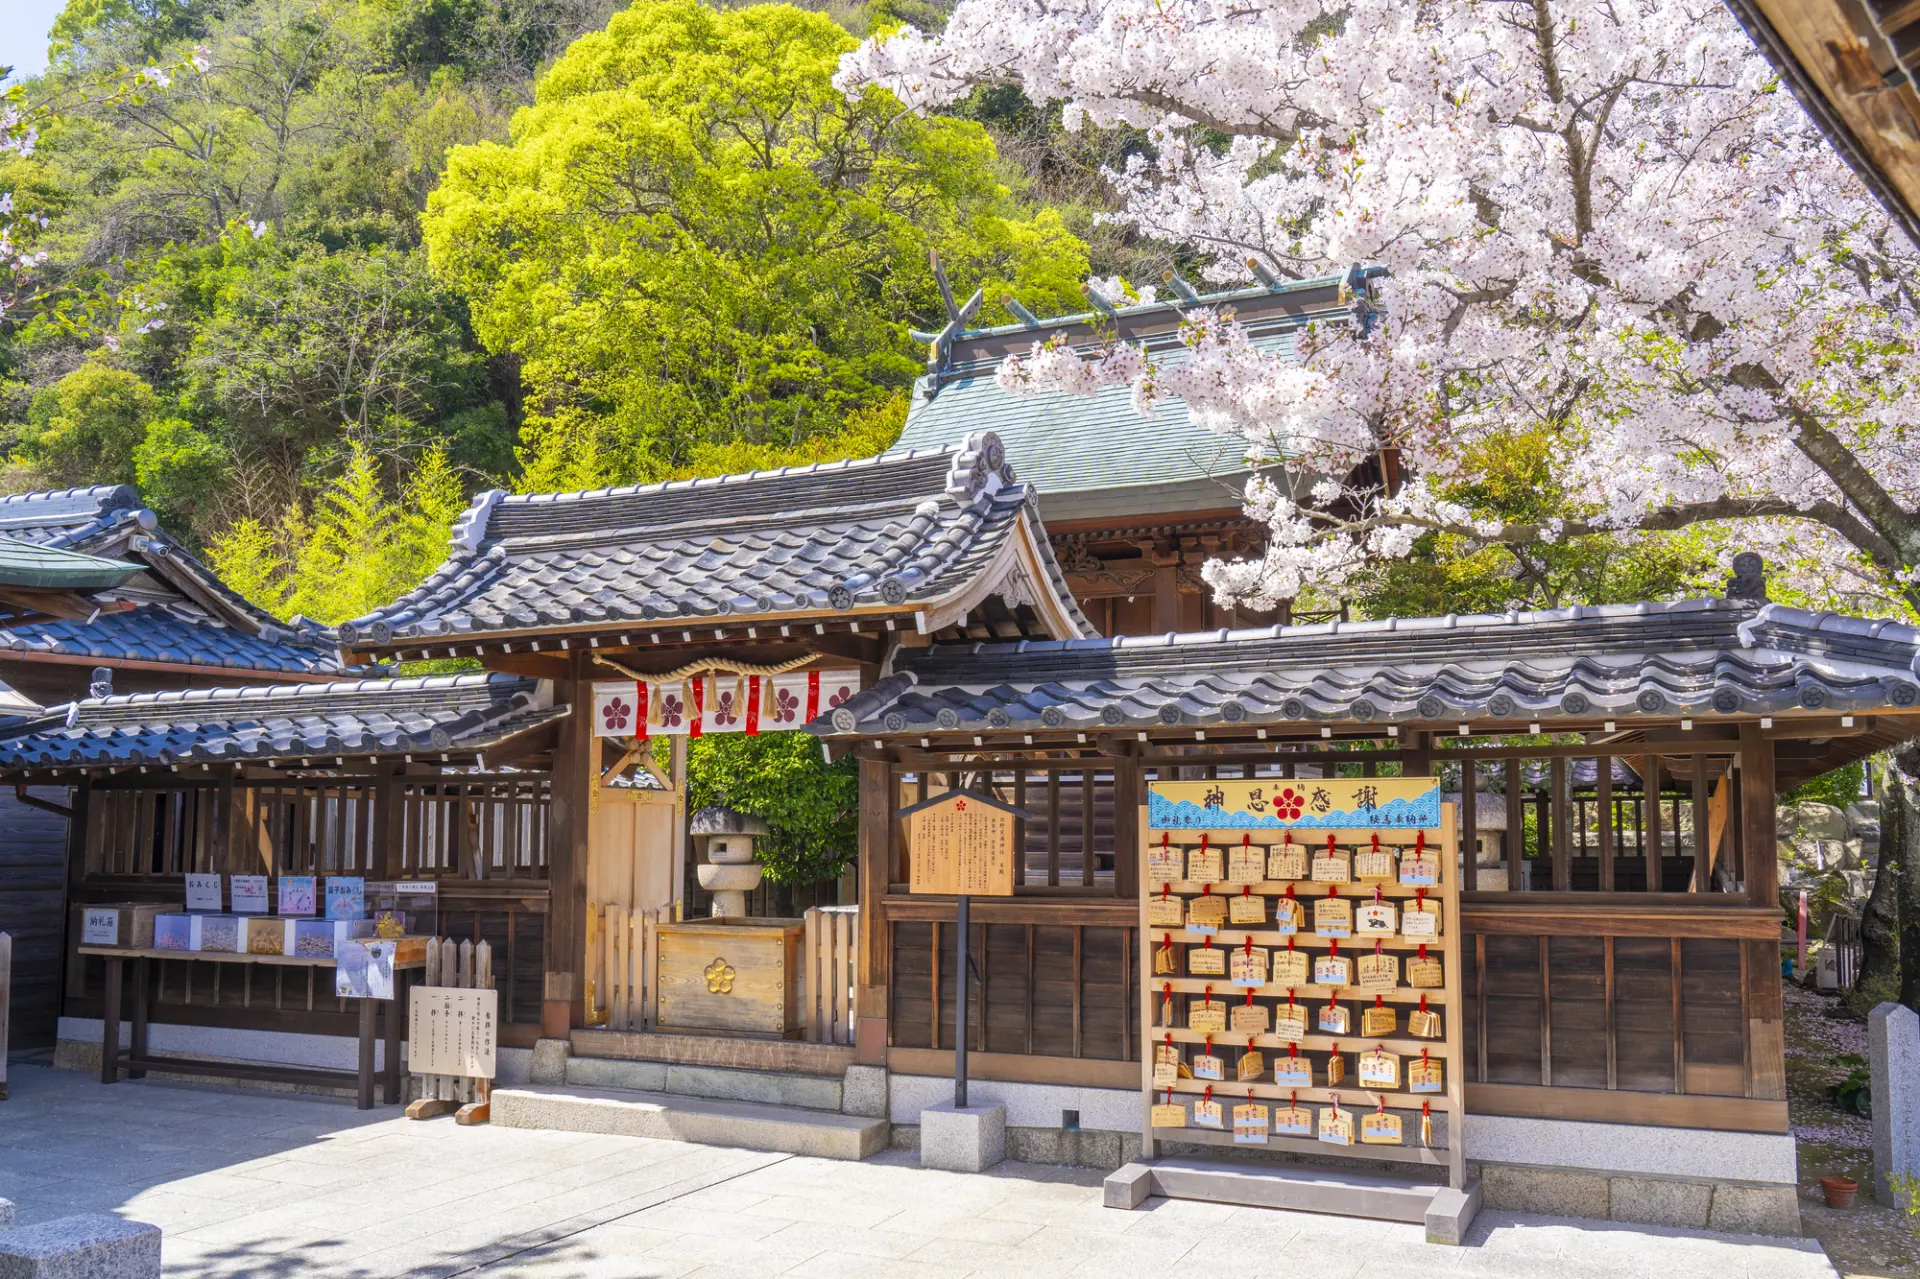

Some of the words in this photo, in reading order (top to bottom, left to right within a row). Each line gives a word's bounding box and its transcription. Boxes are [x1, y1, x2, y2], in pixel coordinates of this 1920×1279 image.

[1203, 784, 1379, 815] 神恩感謝
[189, 880, 219, 889] おみくじ
